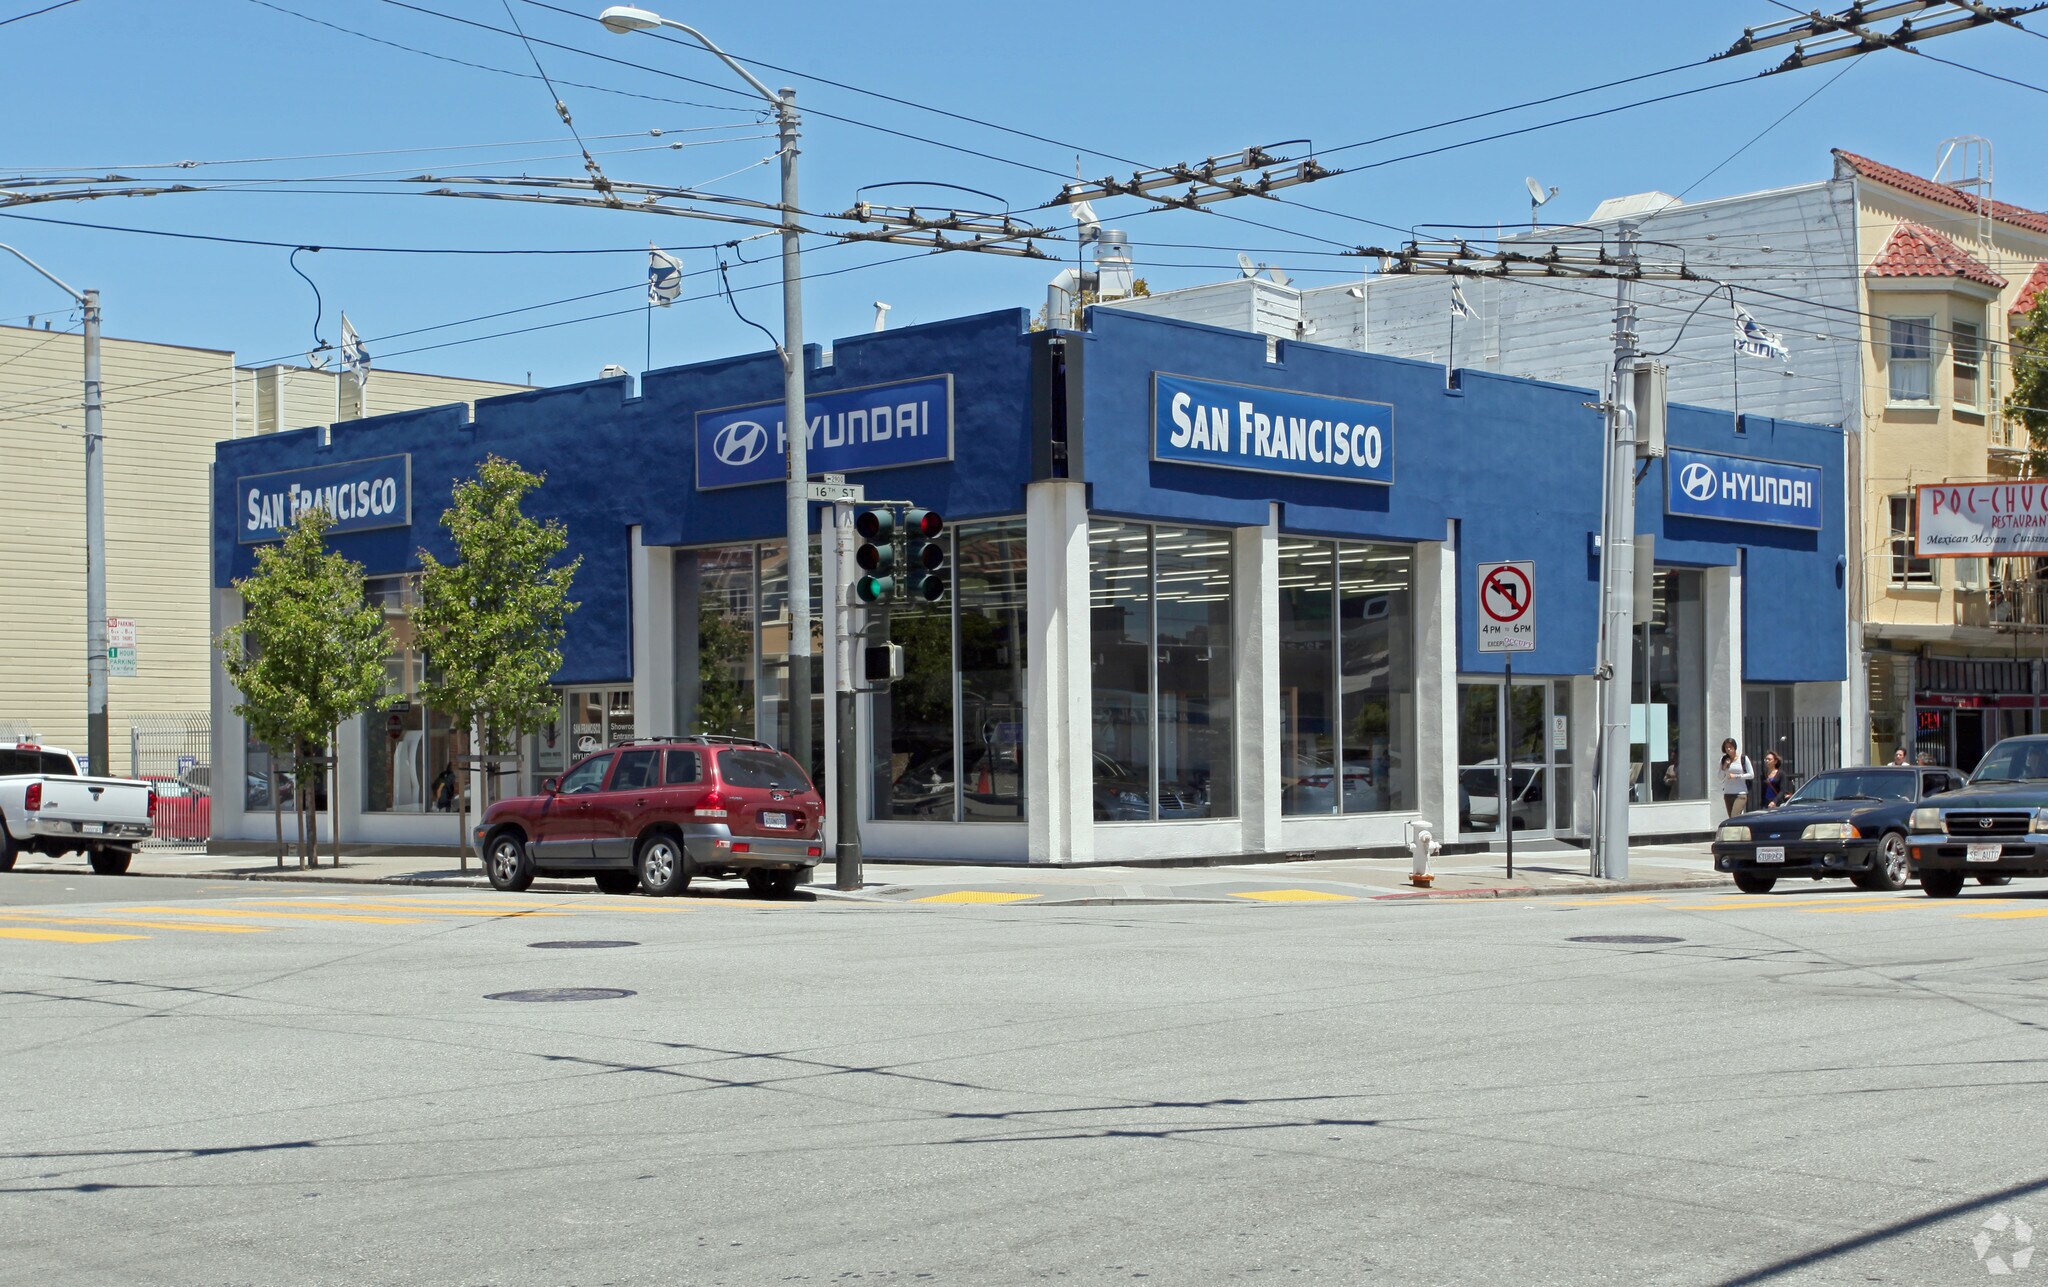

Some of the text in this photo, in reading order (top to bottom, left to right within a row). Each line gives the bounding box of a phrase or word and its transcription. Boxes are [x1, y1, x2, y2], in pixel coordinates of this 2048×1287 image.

[1170, 391, 1382, 469] SAN FRANCISCO
[842, 488, 855, 497] ST
[1722, 471, 1812, 509] HYUNDAI
[1933, 485, 2048, 515] POC-CHUC
[247, 488, 284, 531] SAN
[1992, 514, 2048, 529] RESTAURAN
[1926, 534, 1968, 546] Mexican
[1970, 534, 2007, 547] Mayan
[610, 722, 634, 731] Showroo
[613, 732, 634, 740] Entranc
